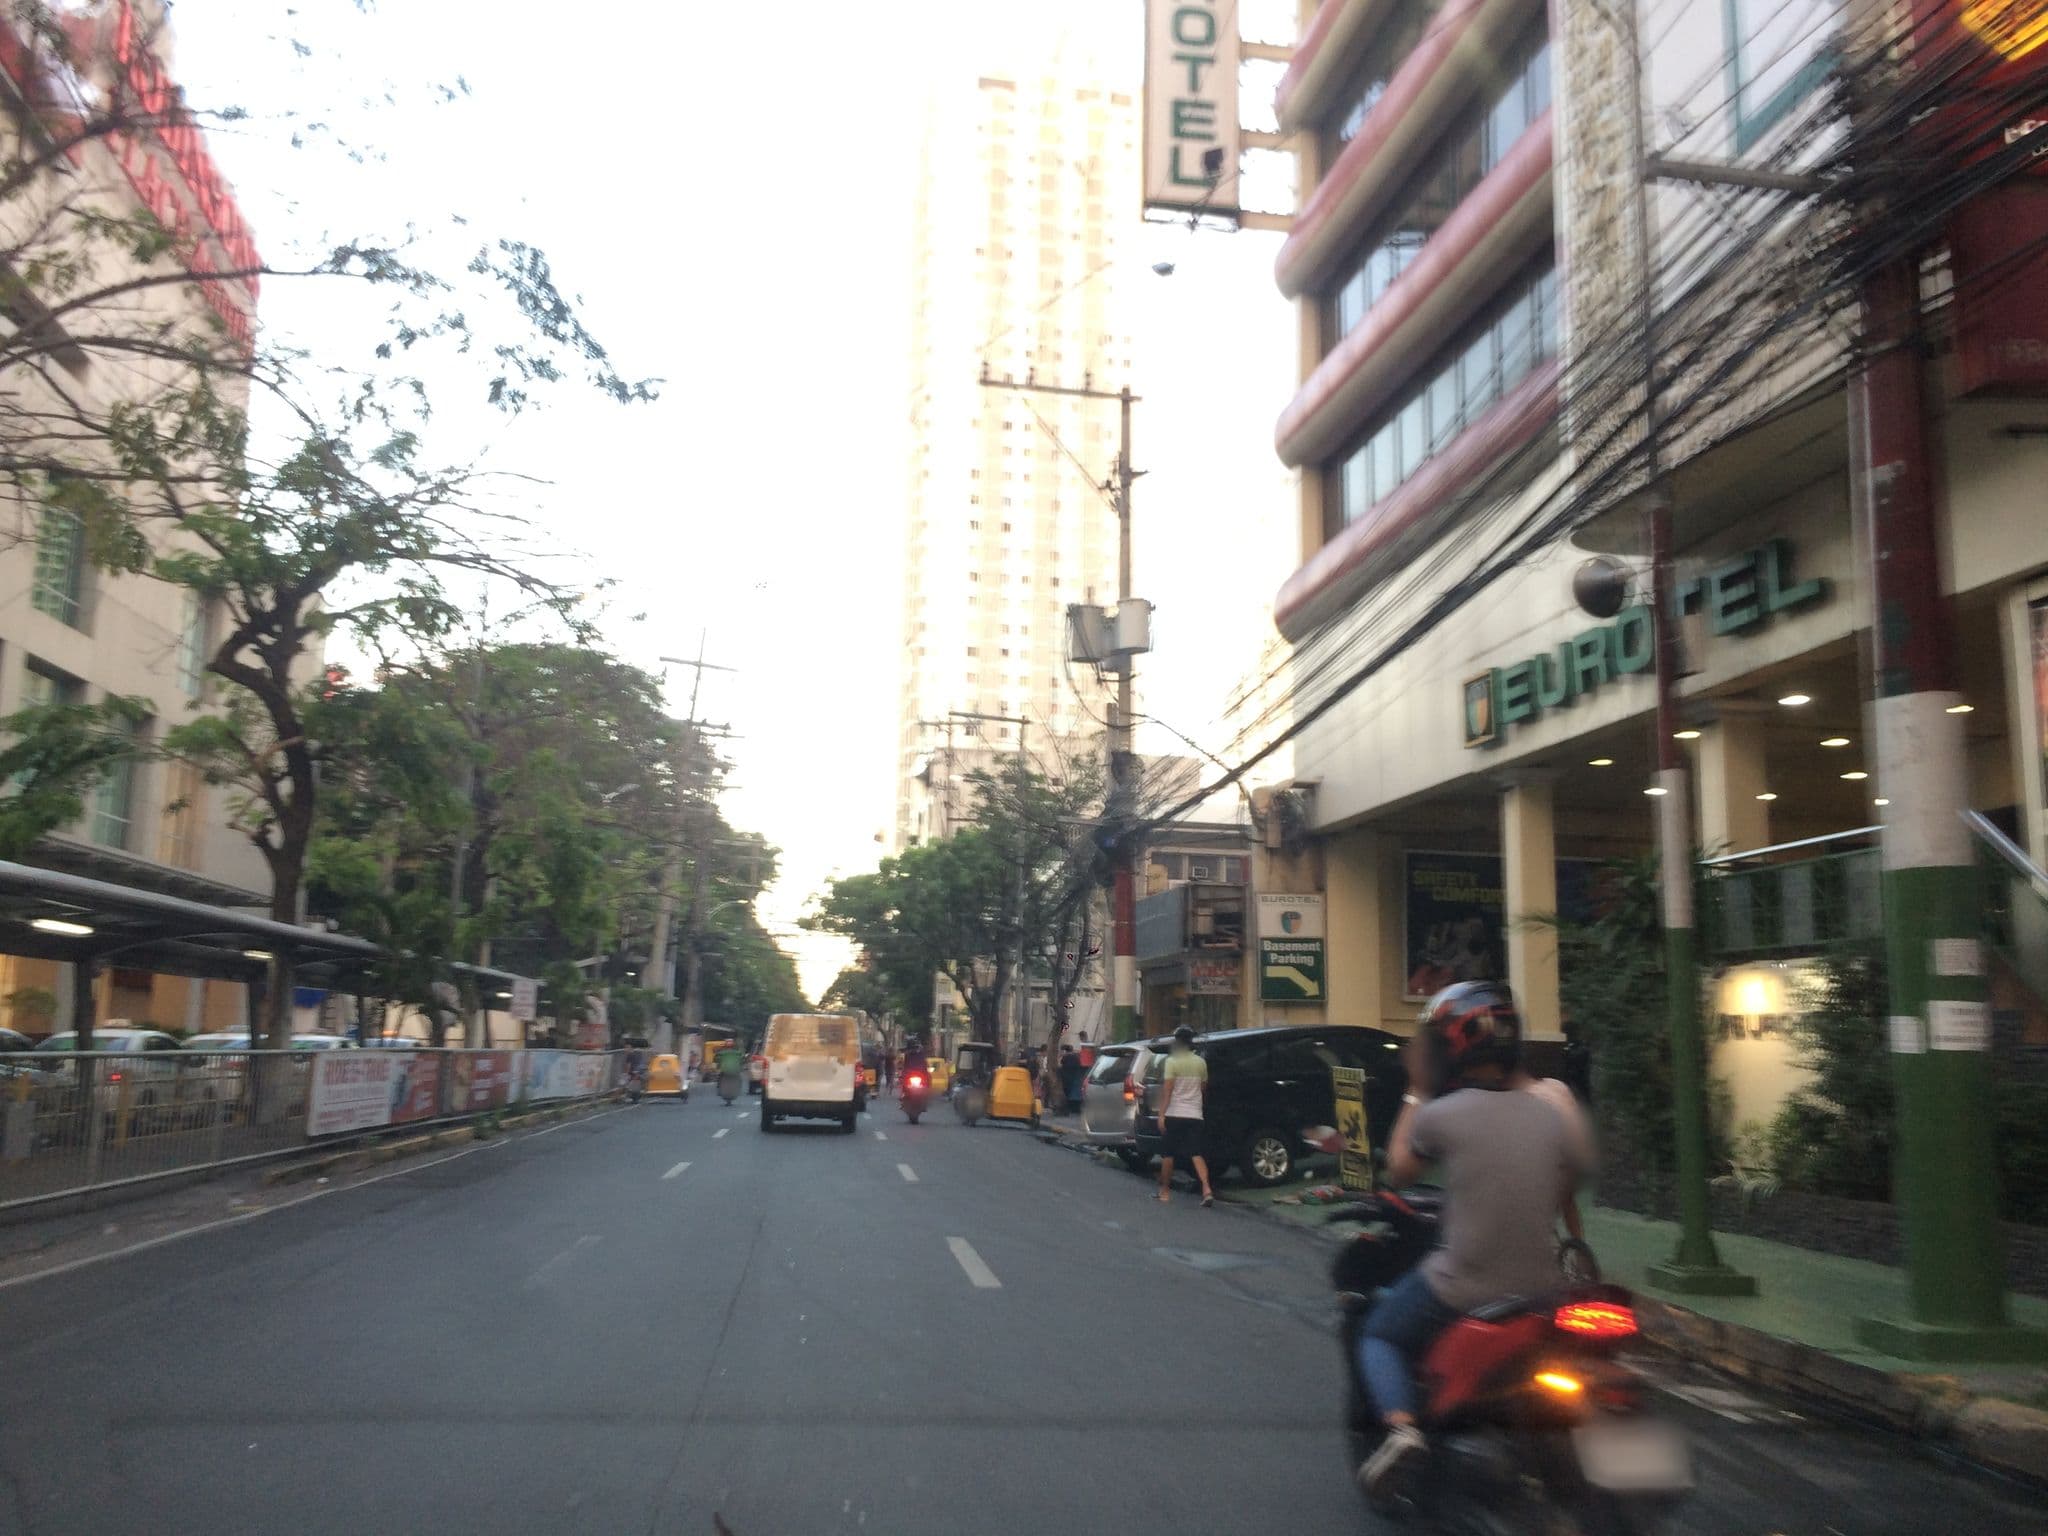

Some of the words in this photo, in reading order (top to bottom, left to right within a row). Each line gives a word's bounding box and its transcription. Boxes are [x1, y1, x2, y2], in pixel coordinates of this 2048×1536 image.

[1170, 0, 1217, 187] OTEL
[1261, 895, 1320, 904] EUROTEL
[1263, 940, 1321, 951] Basement
[1270, 952, 1315, 967] Parking
